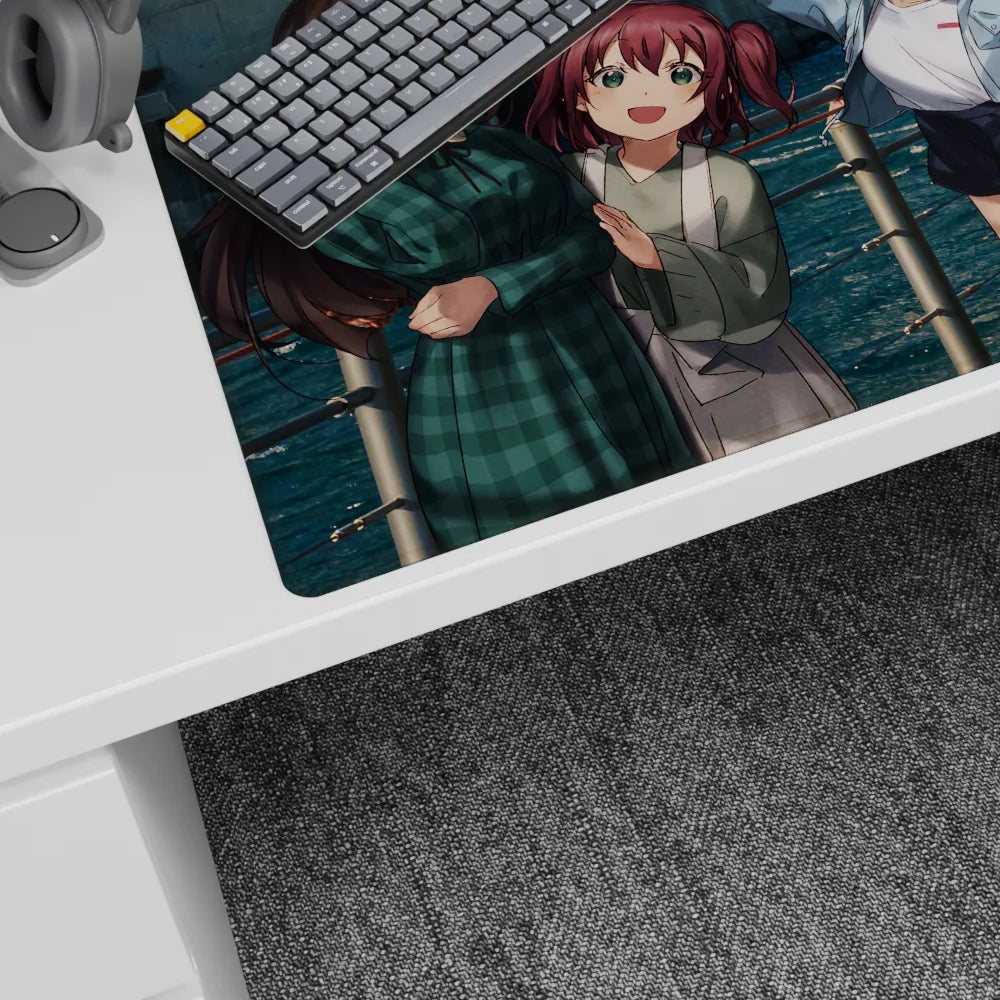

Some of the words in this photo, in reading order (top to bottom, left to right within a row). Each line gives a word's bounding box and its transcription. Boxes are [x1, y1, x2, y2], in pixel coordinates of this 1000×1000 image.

[354, 148, 379, 168] command
[326, 176, 343, 190] option
[292, 199, 311, 215] control
